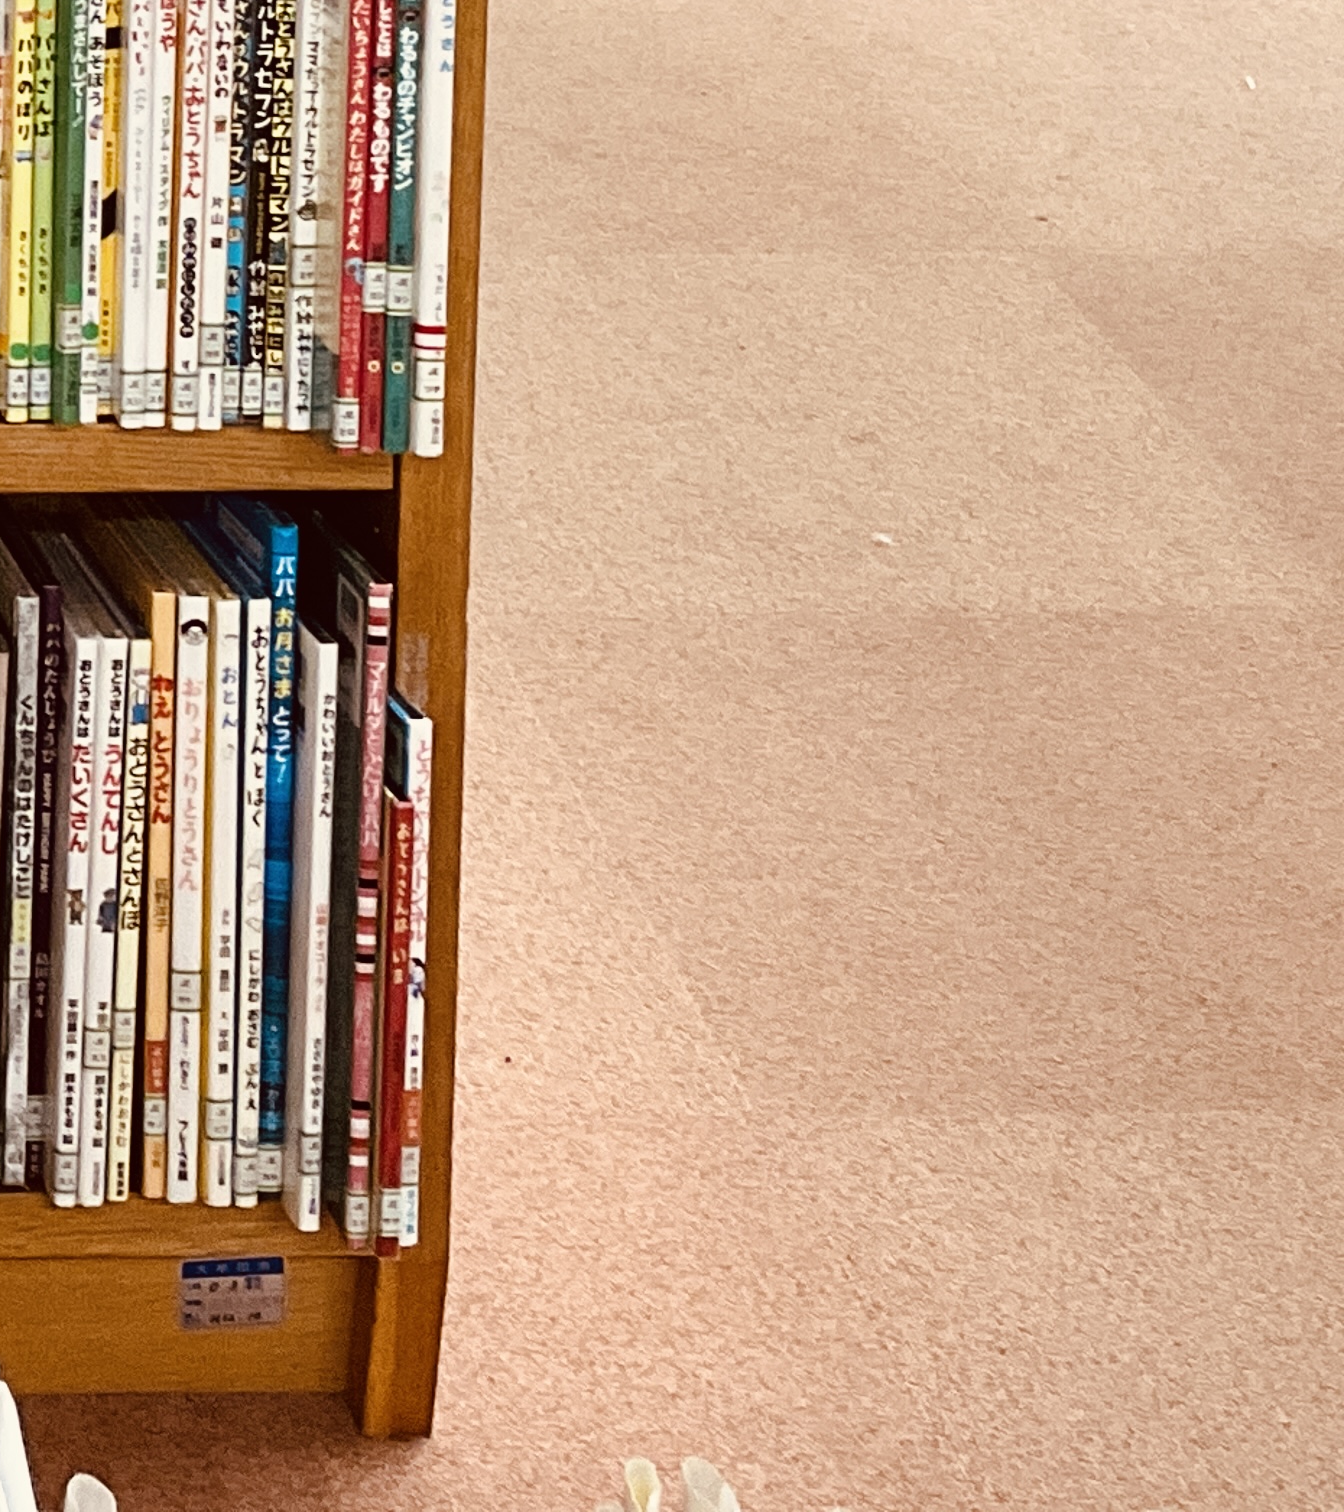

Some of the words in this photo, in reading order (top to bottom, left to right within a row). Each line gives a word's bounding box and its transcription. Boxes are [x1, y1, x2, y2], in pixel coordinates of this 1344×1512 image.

[87, 37, 106, 107] あそぼう
[213, 21, 232, 99] いわないの
[370, 82, 394, 194] わるものです
[347, 111, 367, 253] わたしはガイドさん
[272, 607, 294, 699] お月さま
[77, 659, 93, 739] おとうさんは
[108, 658, 124, 738] おとうさんは
[150, 673, 174, 720] ねえ
[150, 730, 173, 825] とうさん
[270, 705, 293, 785] とって！
[318, 693, 337, 819] かわいいおとうさん
[100, 743, 123, 856] うんてんし
[119, 737, 149, 931] おとうさんとさんぽ
[247, 788, 267, 829] ぼく
